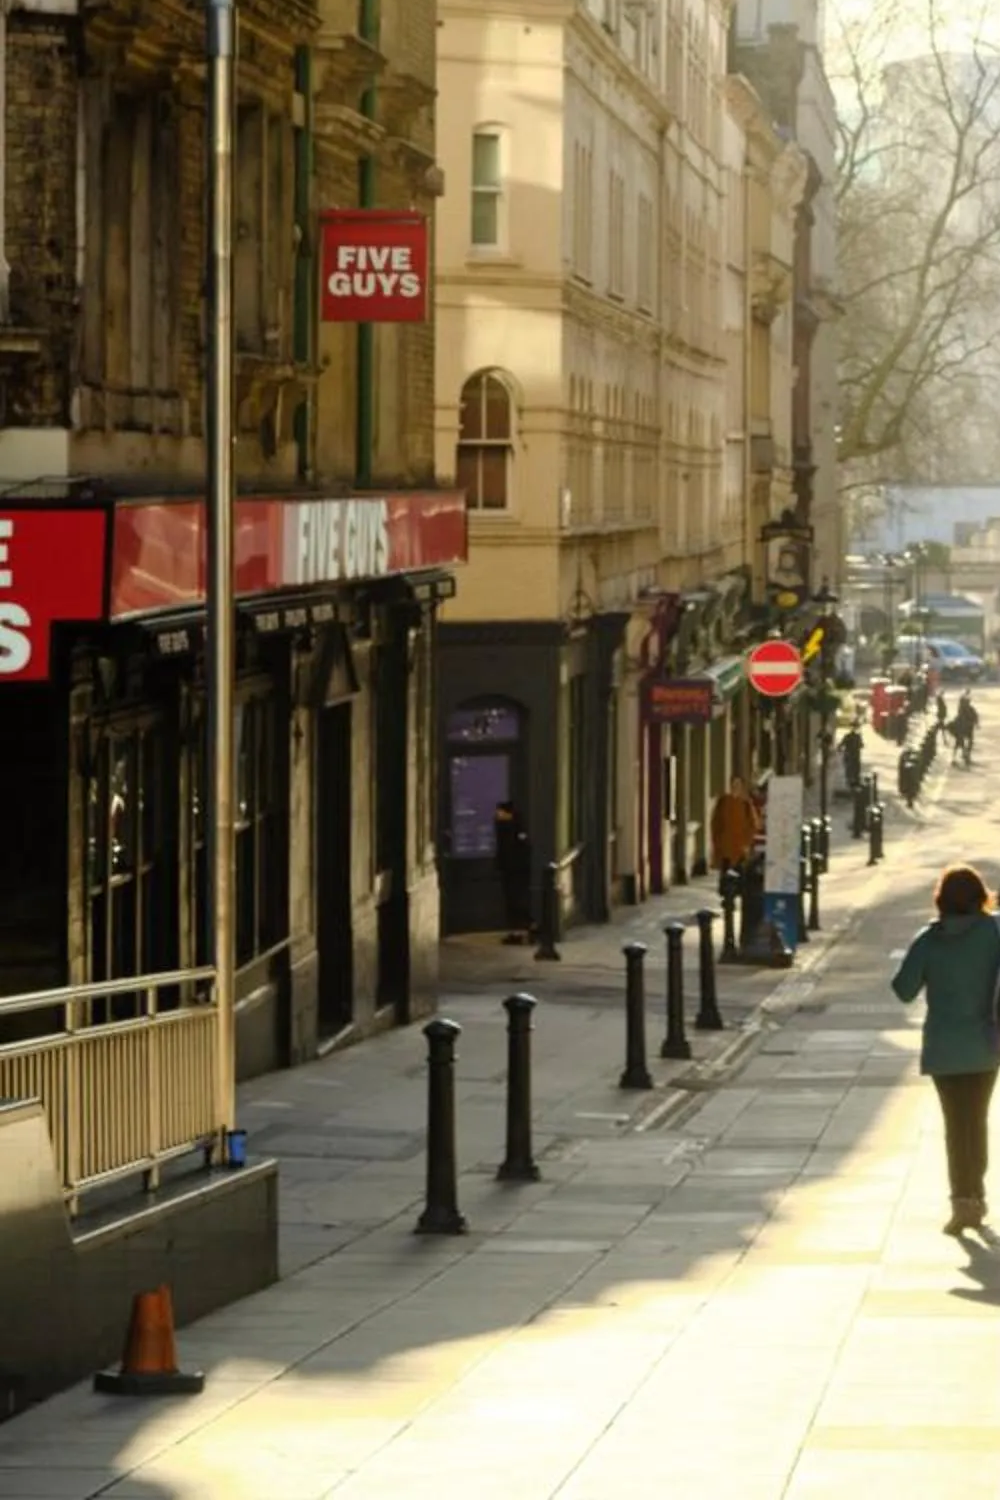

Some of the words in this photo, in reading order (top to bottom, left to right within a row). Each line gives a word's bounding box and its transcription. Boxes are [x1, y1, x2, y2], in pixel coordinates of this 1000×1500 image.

[338, 246, 410, 270] FIVE
[328, 273, 420, 297] GUYS
[298, 501, 341, 584] FIVE
[344, 499, 389, 578] GUYS
